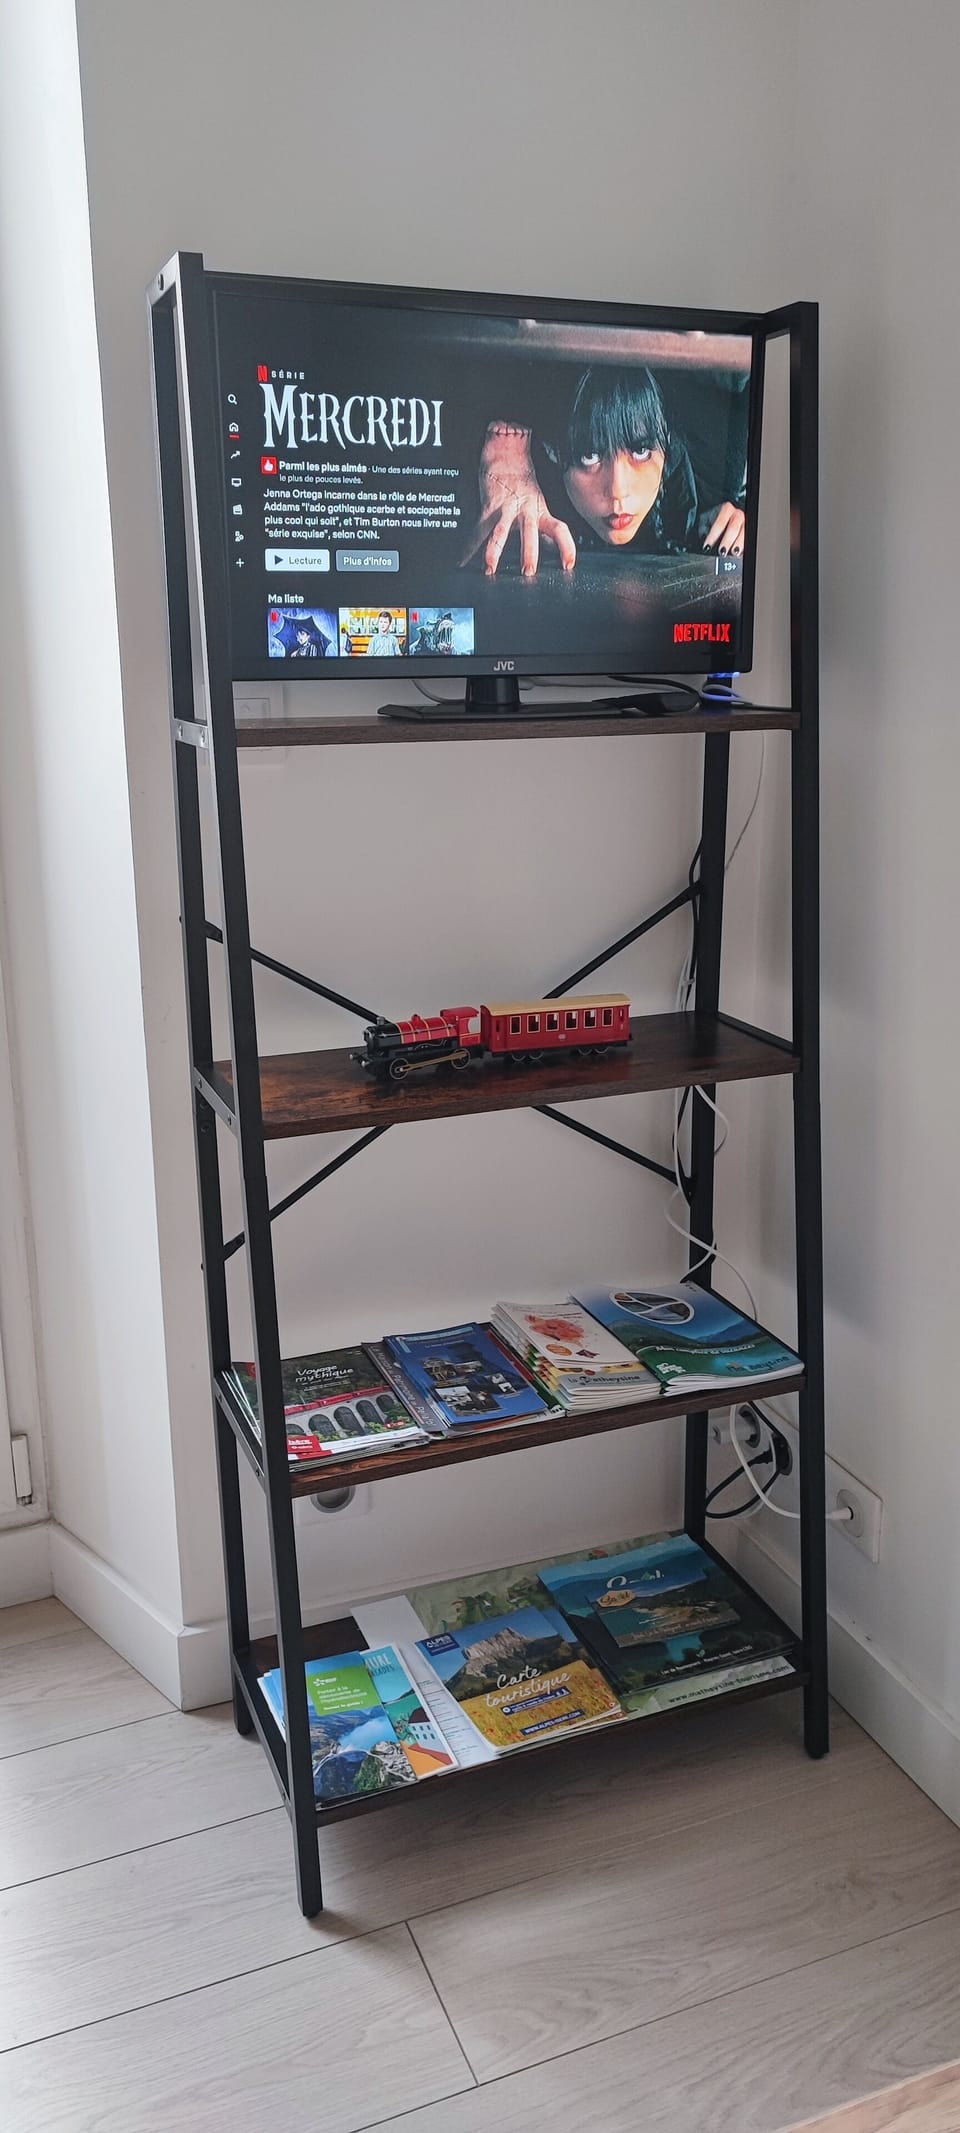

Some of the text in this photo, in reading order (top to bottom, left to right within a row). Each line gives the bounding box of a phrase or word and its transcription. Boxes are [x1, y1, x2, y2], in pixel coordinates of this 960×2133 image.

[271, 369, 305, 380] SÉRIE
[259, 383, 444, 452] MERCREDI
[278, 460, 459, 477] Parmi les plus aimés Une des séries ayant reçu
[287, 474, 303, 483] plus
[304, 475, 314, 483] de
[315, 476, 342, 484] pouces
[342, 475, 363, 484] levés.
[263, 488, 455, 503] Jenna Ortega incarne dans le rôle de Mercredi
[263, 501, 461, 516] Addams "l'ado gothique acerbe et sociopathe la
[264, 515, 458, 528] plus cool qui soit", et Tim Burton nous livre une
[264, 528, 380, 540] "série exquise", selon CNN.
[288, 556, 322, 565] Lecture
[343, 556, 392, 566] Plus d'infos
[723, 562, 737, 571] 13+
[267, 593, 305, 604] Ma liste
[673, 622, 731, 643] NETFLIX
[493, 660, 515, 671] JVC
[295, 1368, 354, 1383] mythique
[296, 1365, 338, 1378] Voyage
[496, 1665, 542, 1689] Carte
[485, 1672, 571, 1707] touristique
